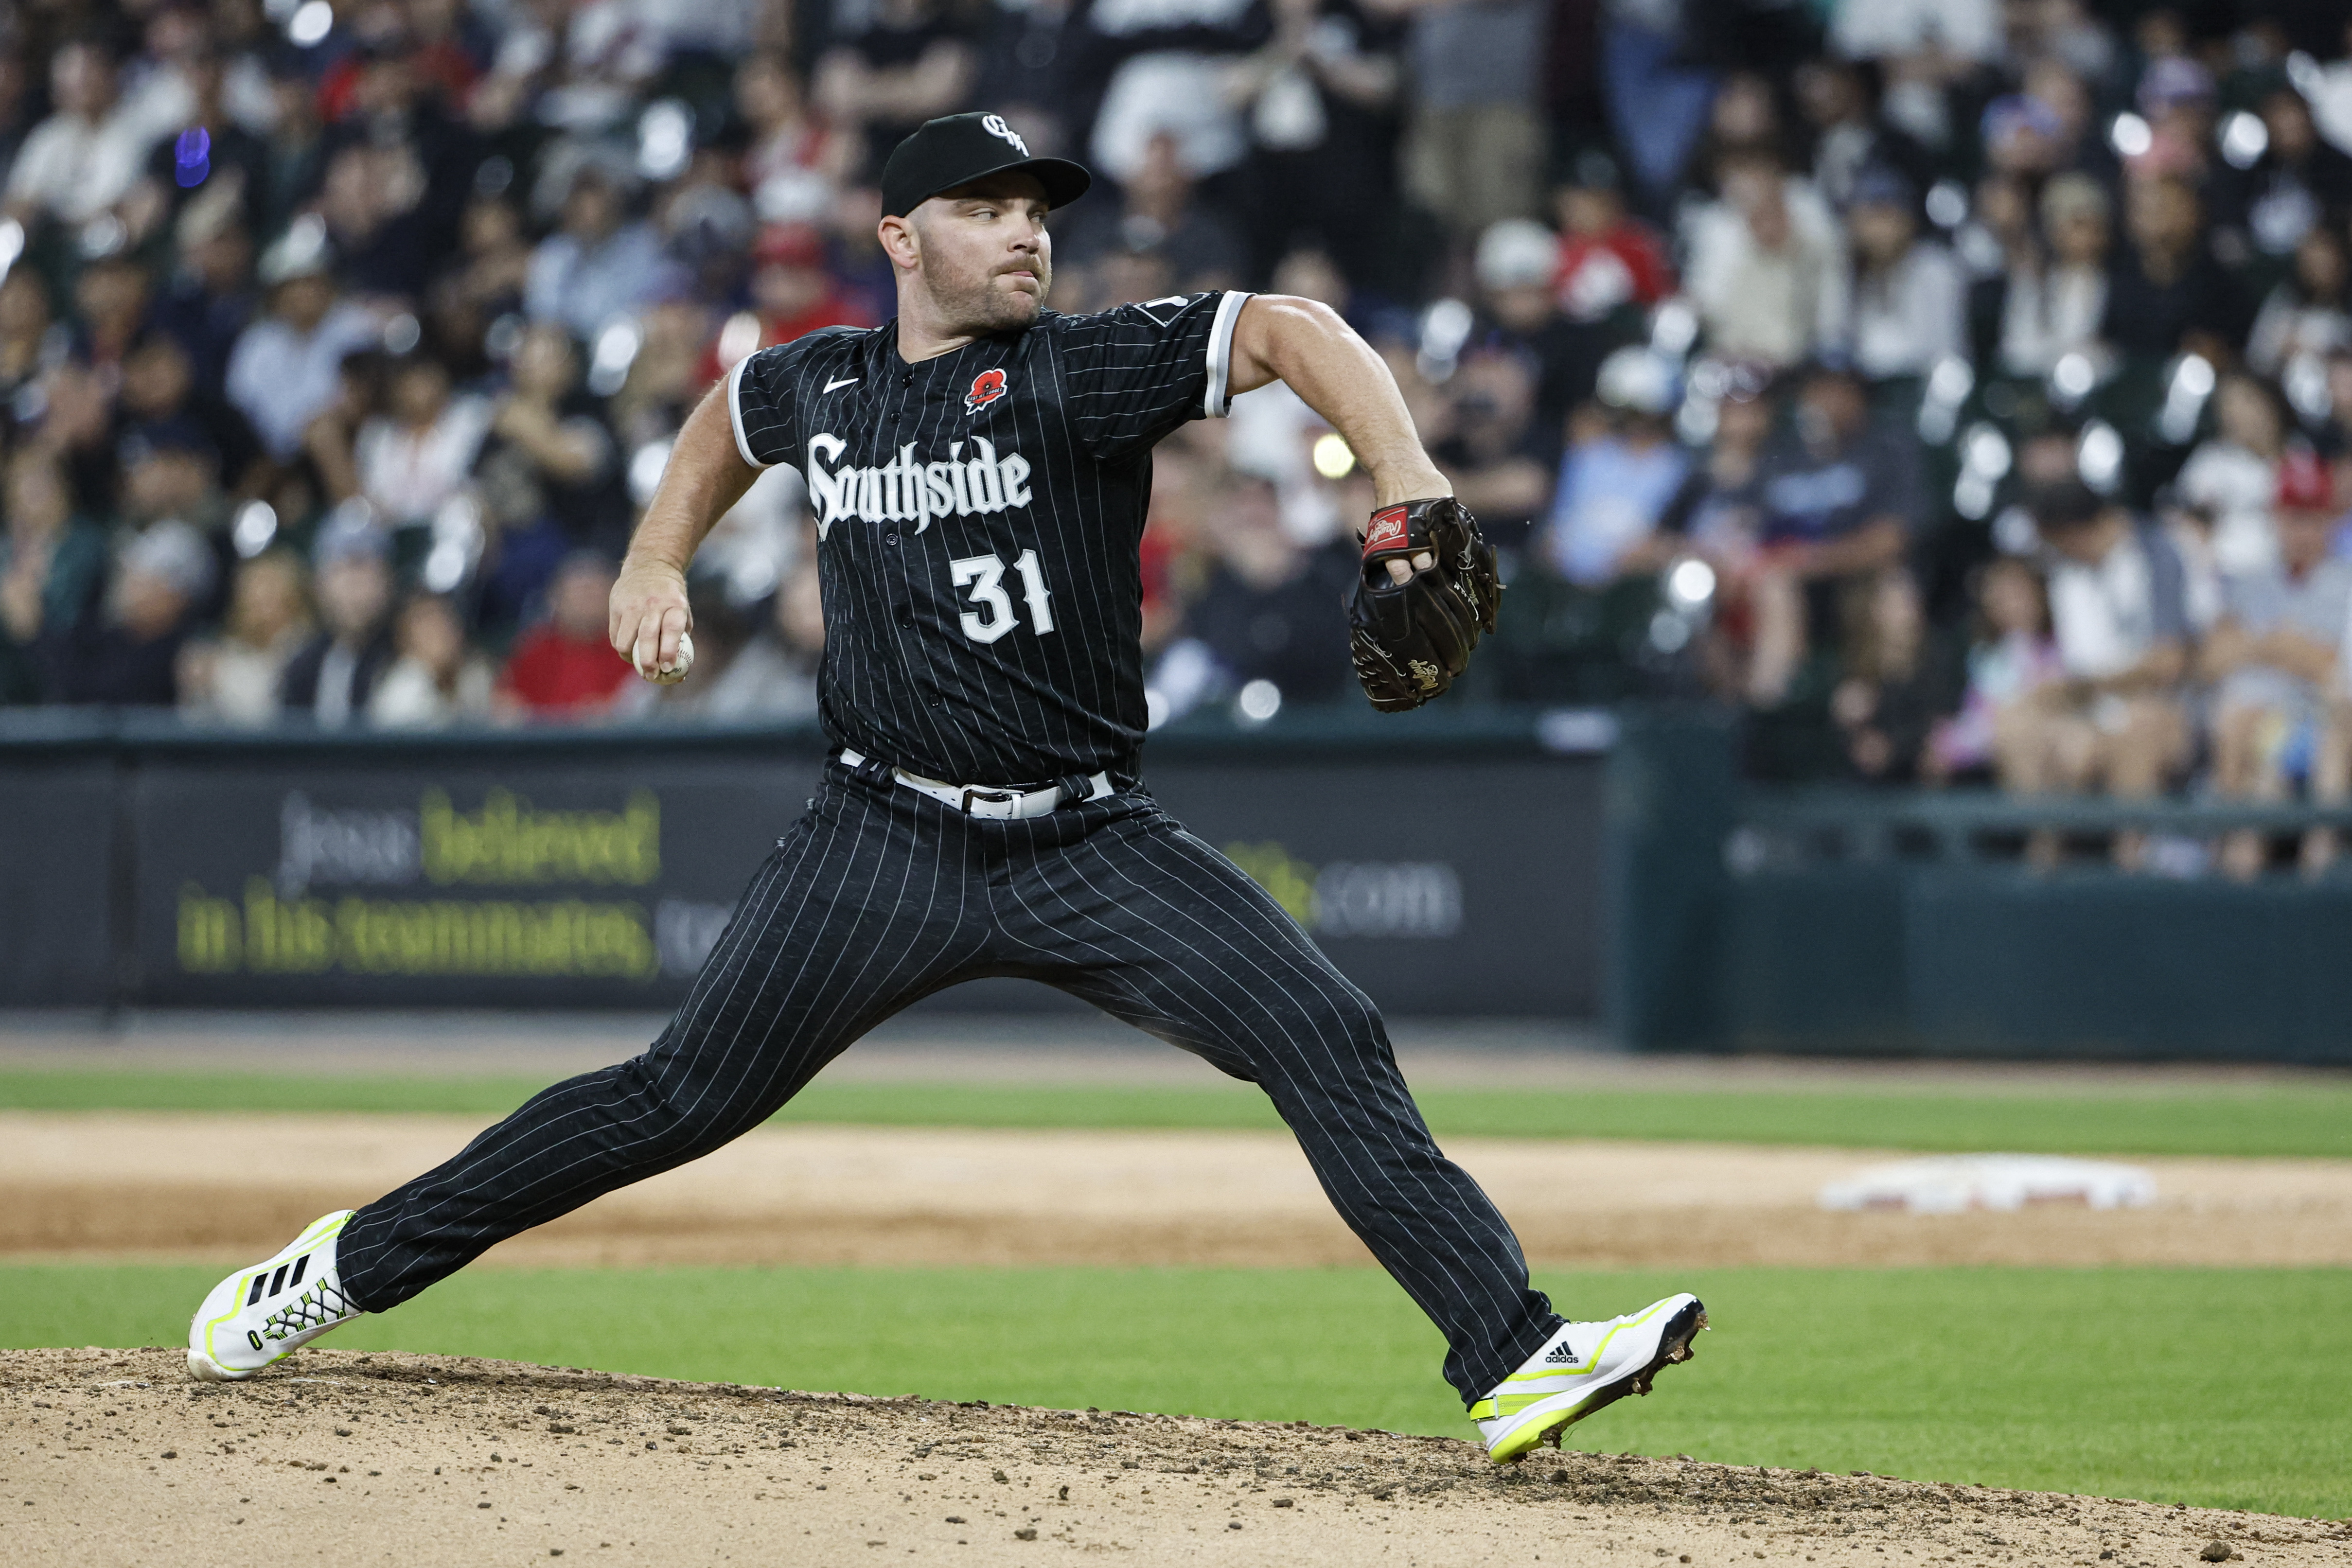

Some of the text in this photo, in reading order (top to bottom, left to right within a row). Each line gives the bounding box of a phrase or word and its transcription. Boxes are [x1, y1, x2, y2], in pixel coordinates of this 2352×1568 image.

[808, 432, 1032, 542] Southside
[949, 548, 1054, 644] 31
[421, 787, 660, 885] believed
[178, 881, 241, 973] in
[245, 876, 334, 973] his
